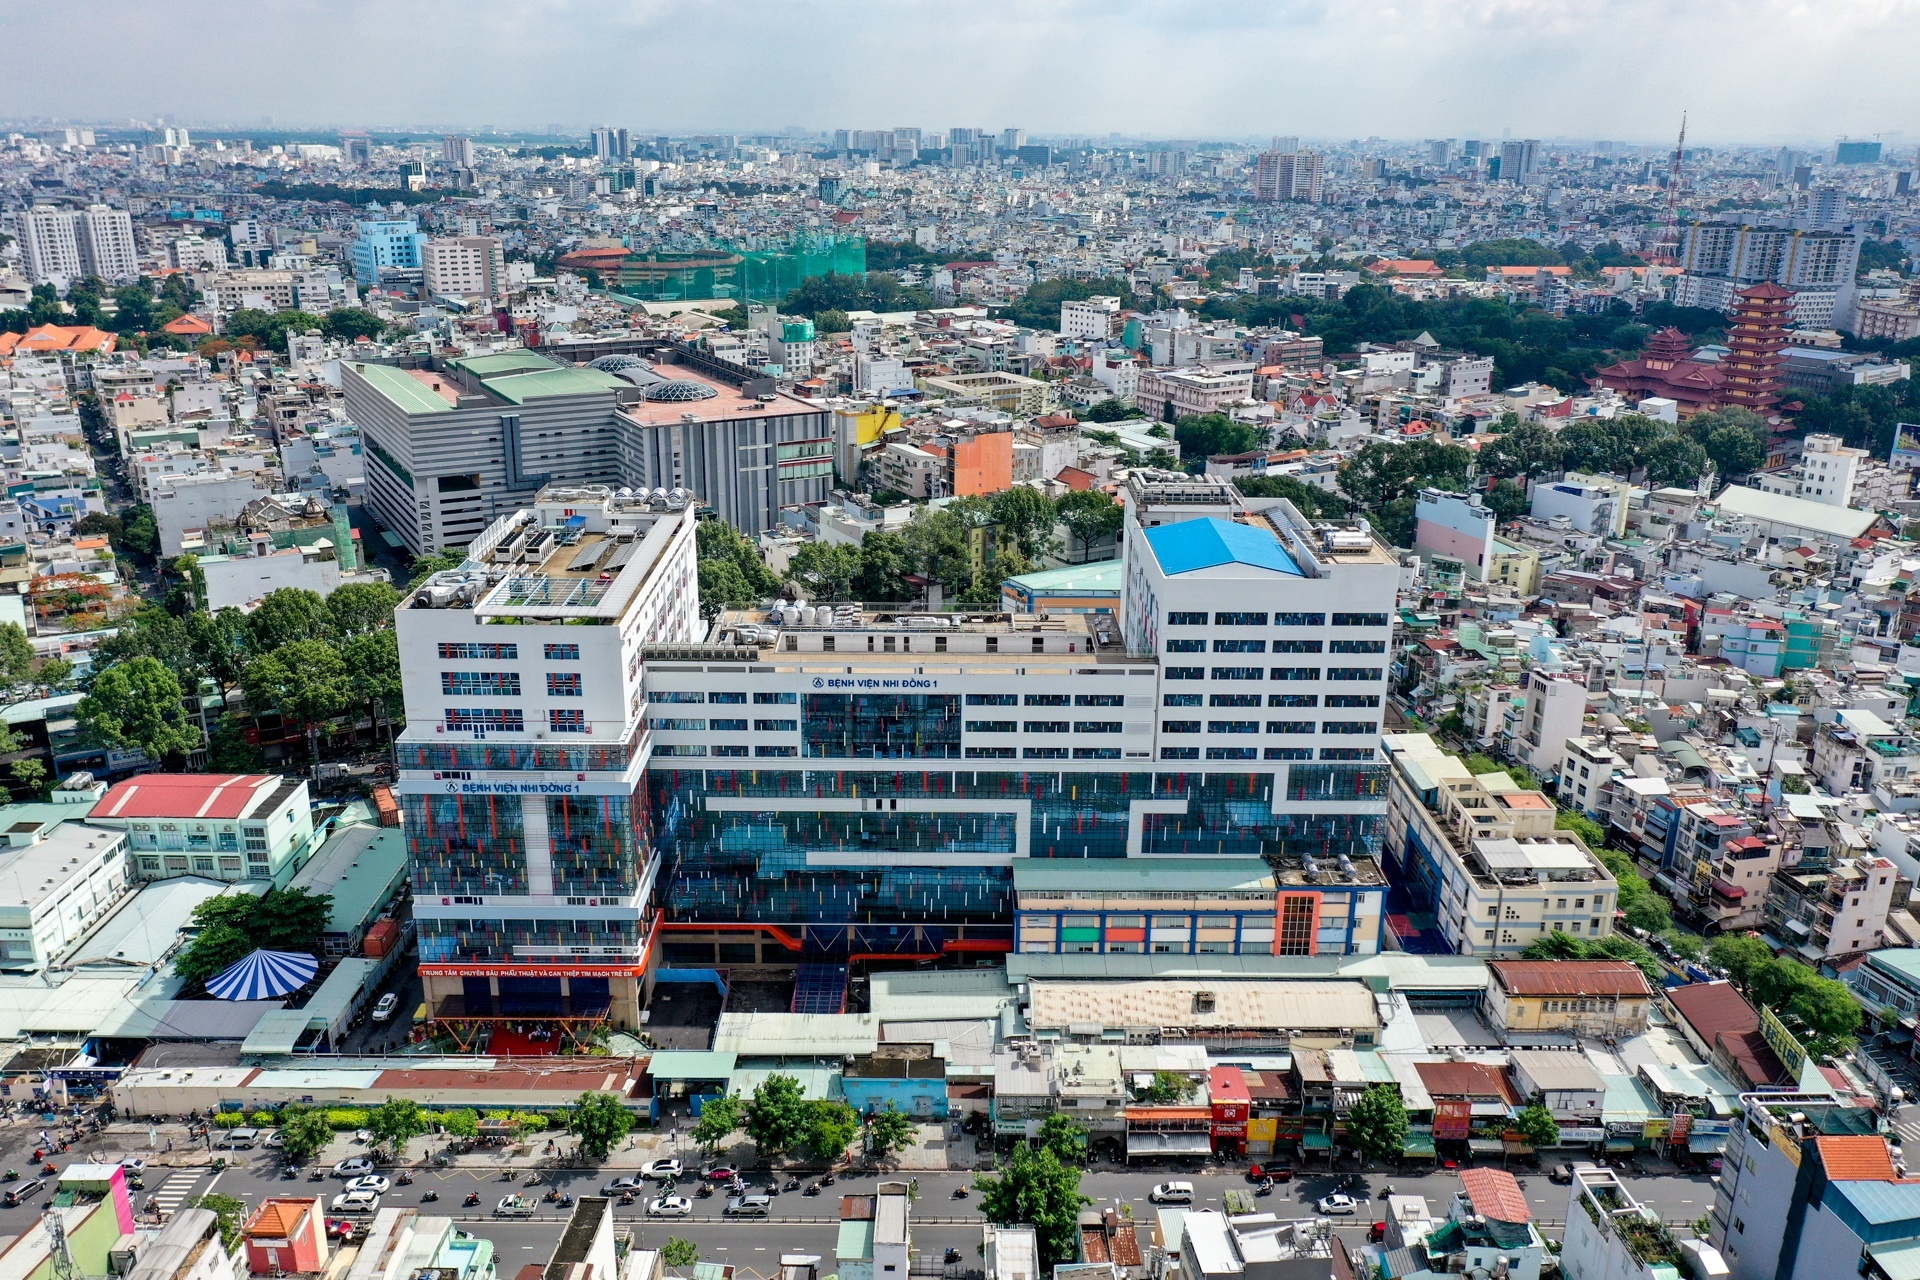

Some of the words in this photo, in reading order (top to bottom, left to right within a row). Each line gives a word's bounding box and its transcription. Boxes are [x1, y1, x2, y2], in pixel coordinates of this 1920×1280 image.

[828, 679, 854, 689] BỆNH
[858, 679, 880, 689] VIỆN
[902, 677, 931, 688] ĐỒNG
[933, 680, 938, 688] 1
[462, 783, 491, 794] BỆNH
[495, 783, 518, 794] VIỆN
[520, 784, 538, 792] NHI
[540, 782, 572, 792] ĐỒNG
[574, 784, 580, 792] 1
